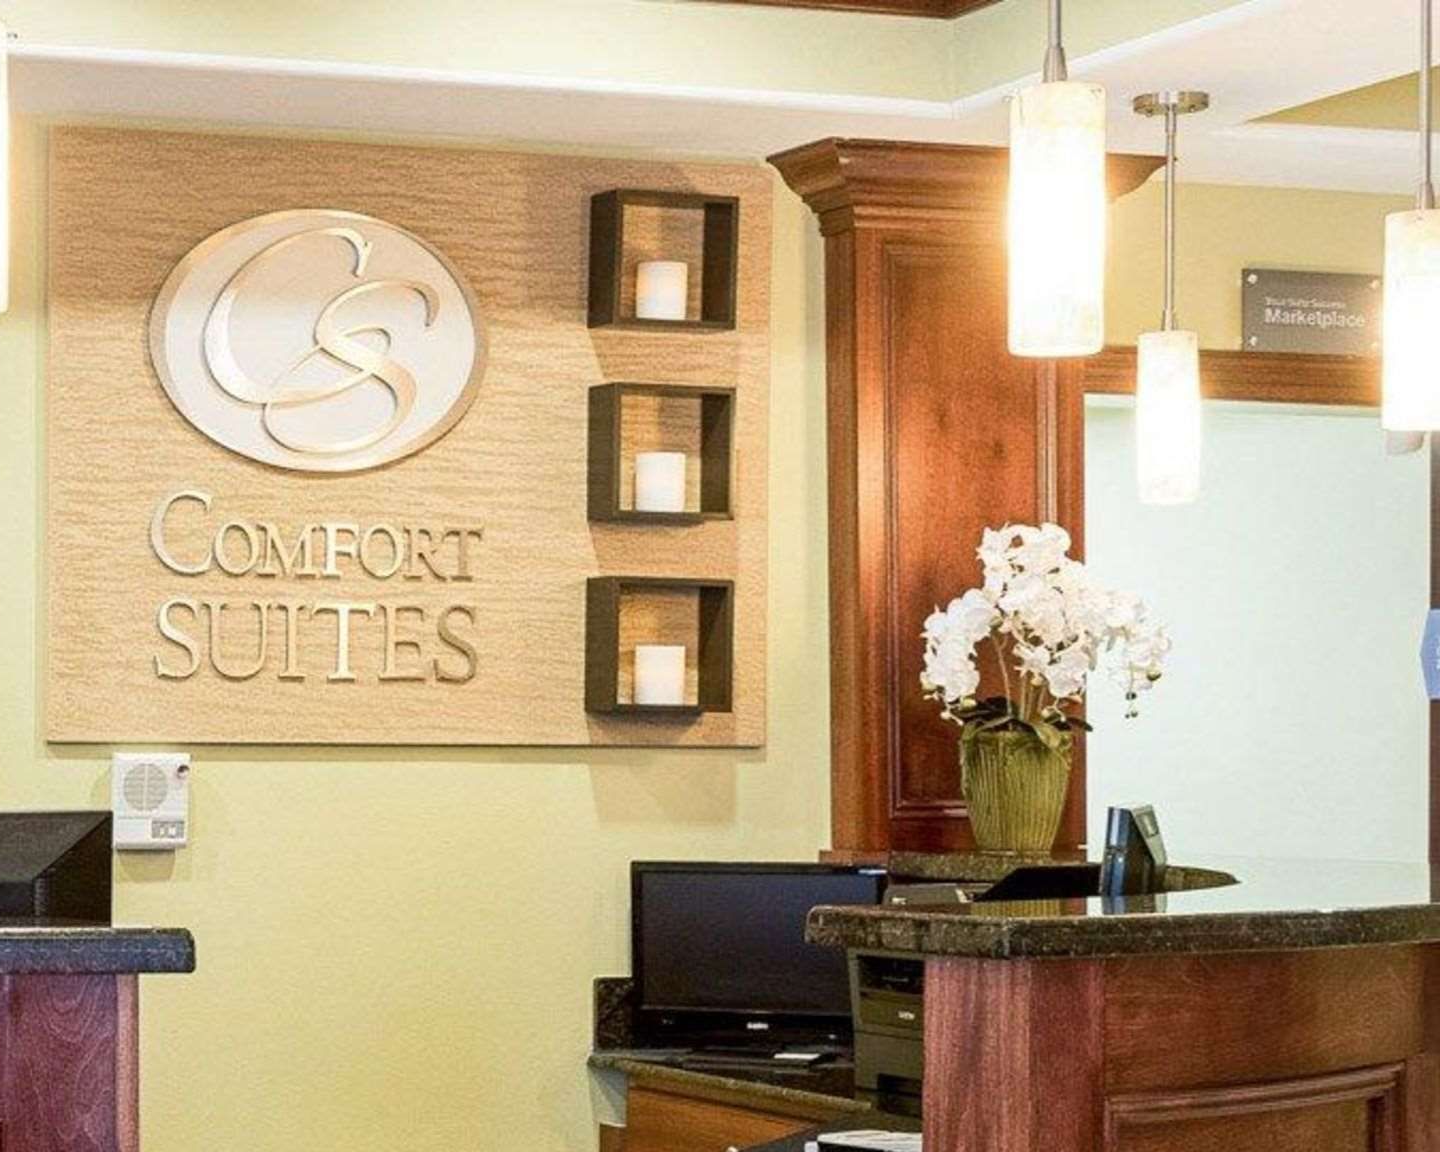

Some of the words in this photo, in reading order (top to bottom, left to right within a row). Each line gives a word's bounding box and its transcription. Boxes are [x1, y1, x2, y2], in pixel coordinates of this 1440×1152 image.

[1264, 308, 1366, 328] Marketplace
[148, 489, 485, 583] COMFORT
[153, 599, 479, 685] SUITES
